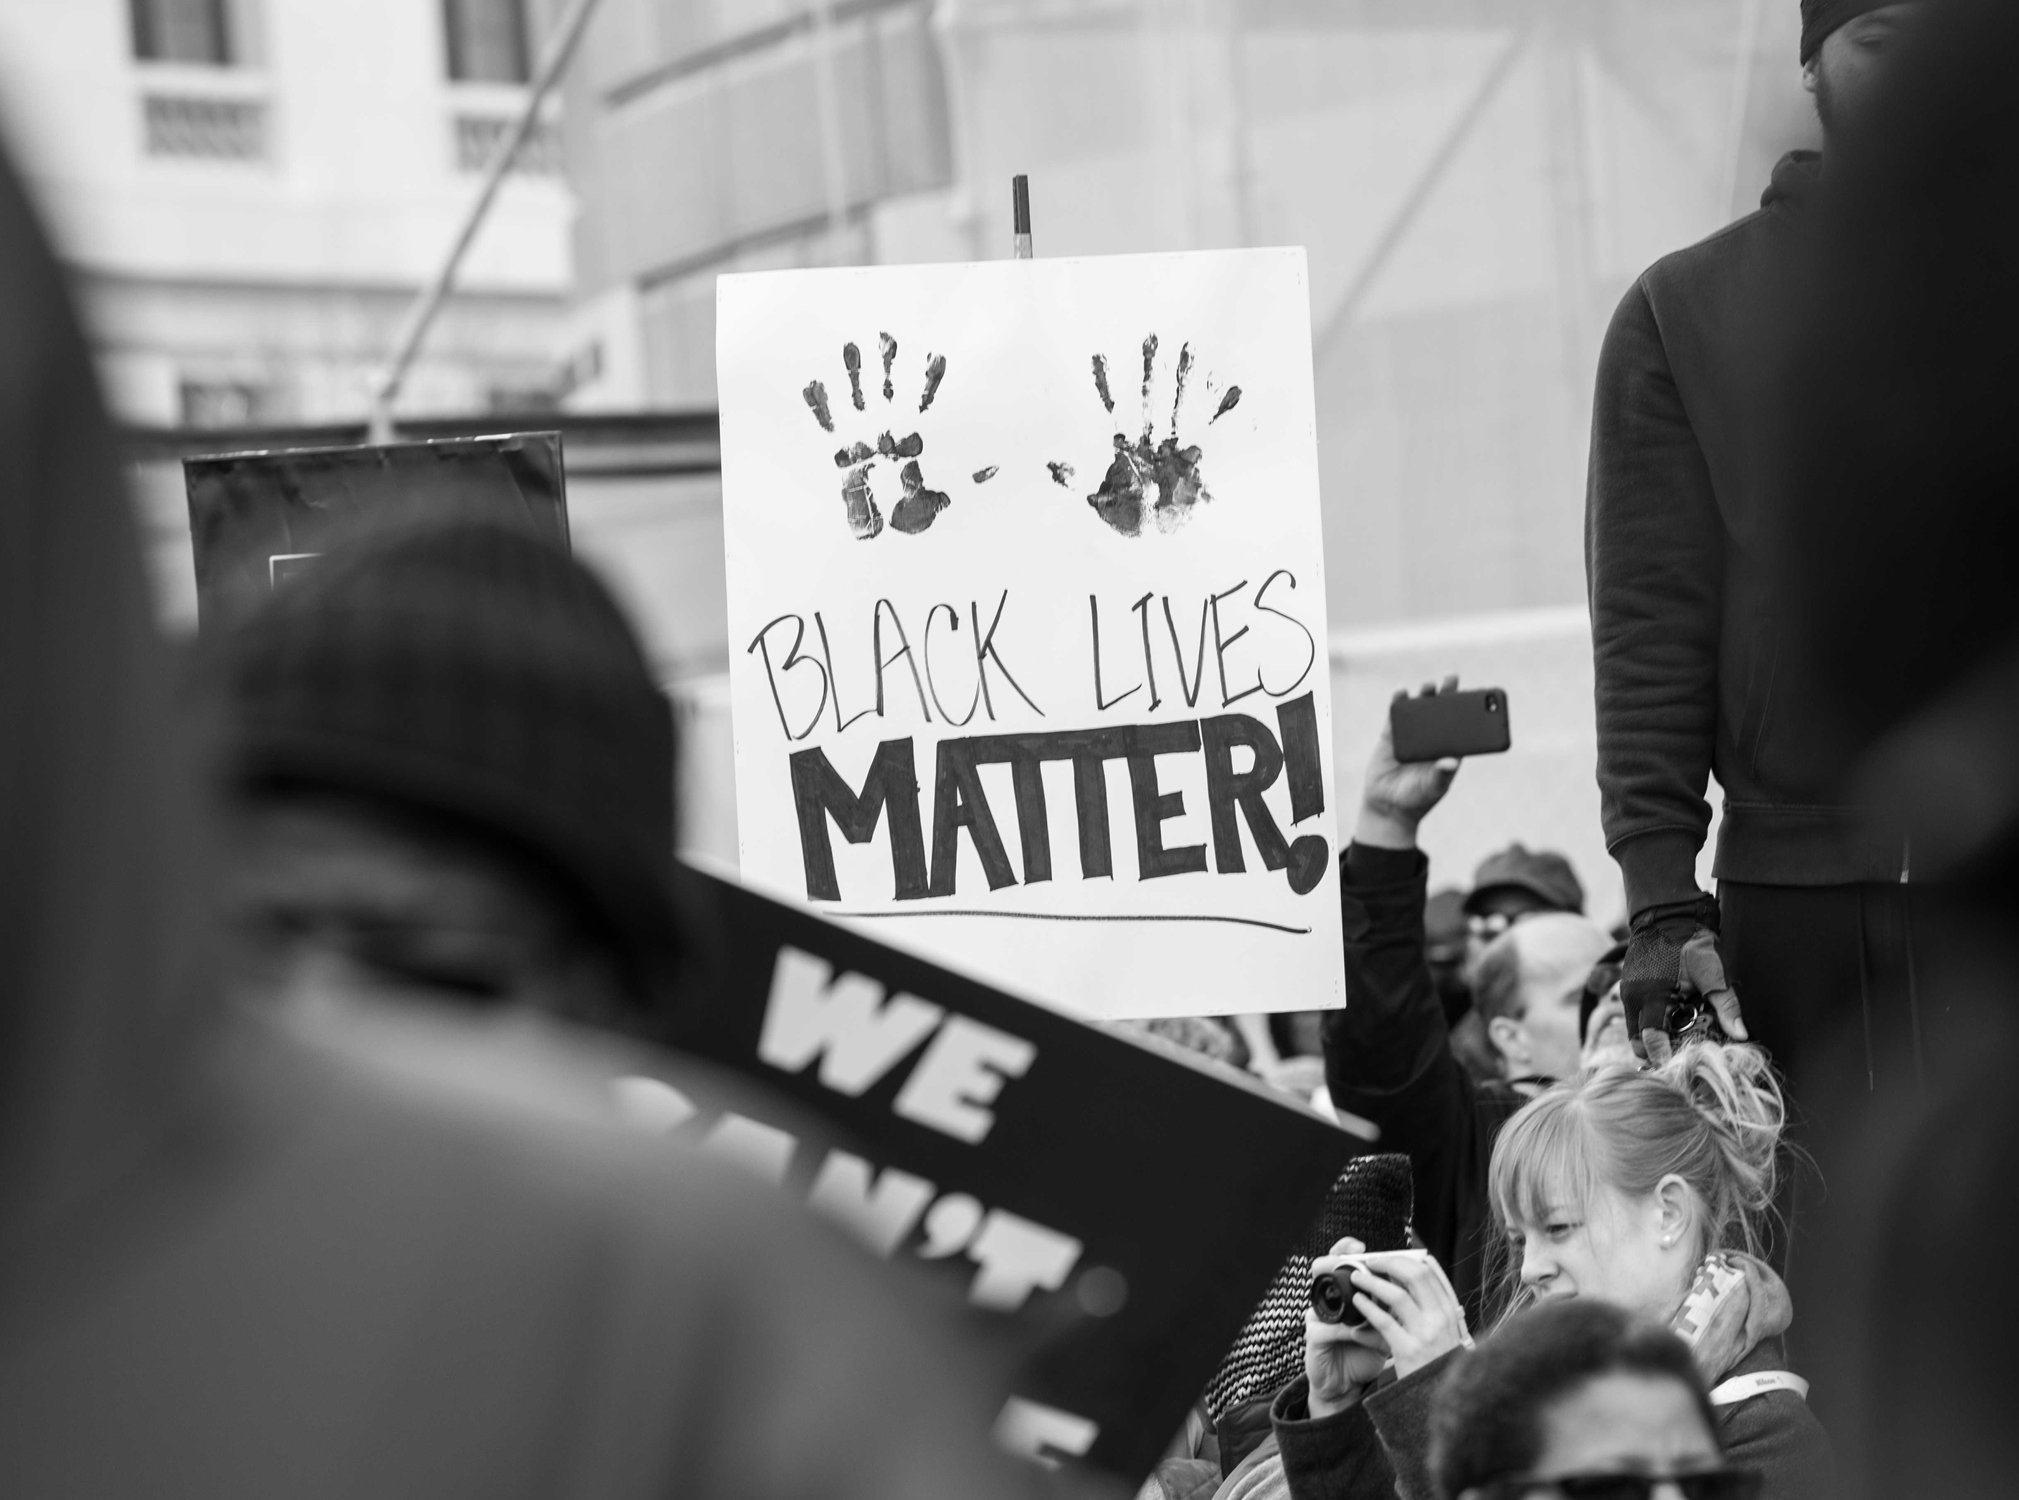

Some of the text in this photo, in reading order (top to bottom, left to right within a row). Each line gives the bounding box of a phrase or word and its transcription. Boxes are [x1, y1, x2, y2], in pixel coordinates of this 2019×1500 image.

[747, 569, 1316, 742] BLACK LIVES
[788, 690, 1330, 902] MATTER!
[757, 943, 1039, 1146] WE
